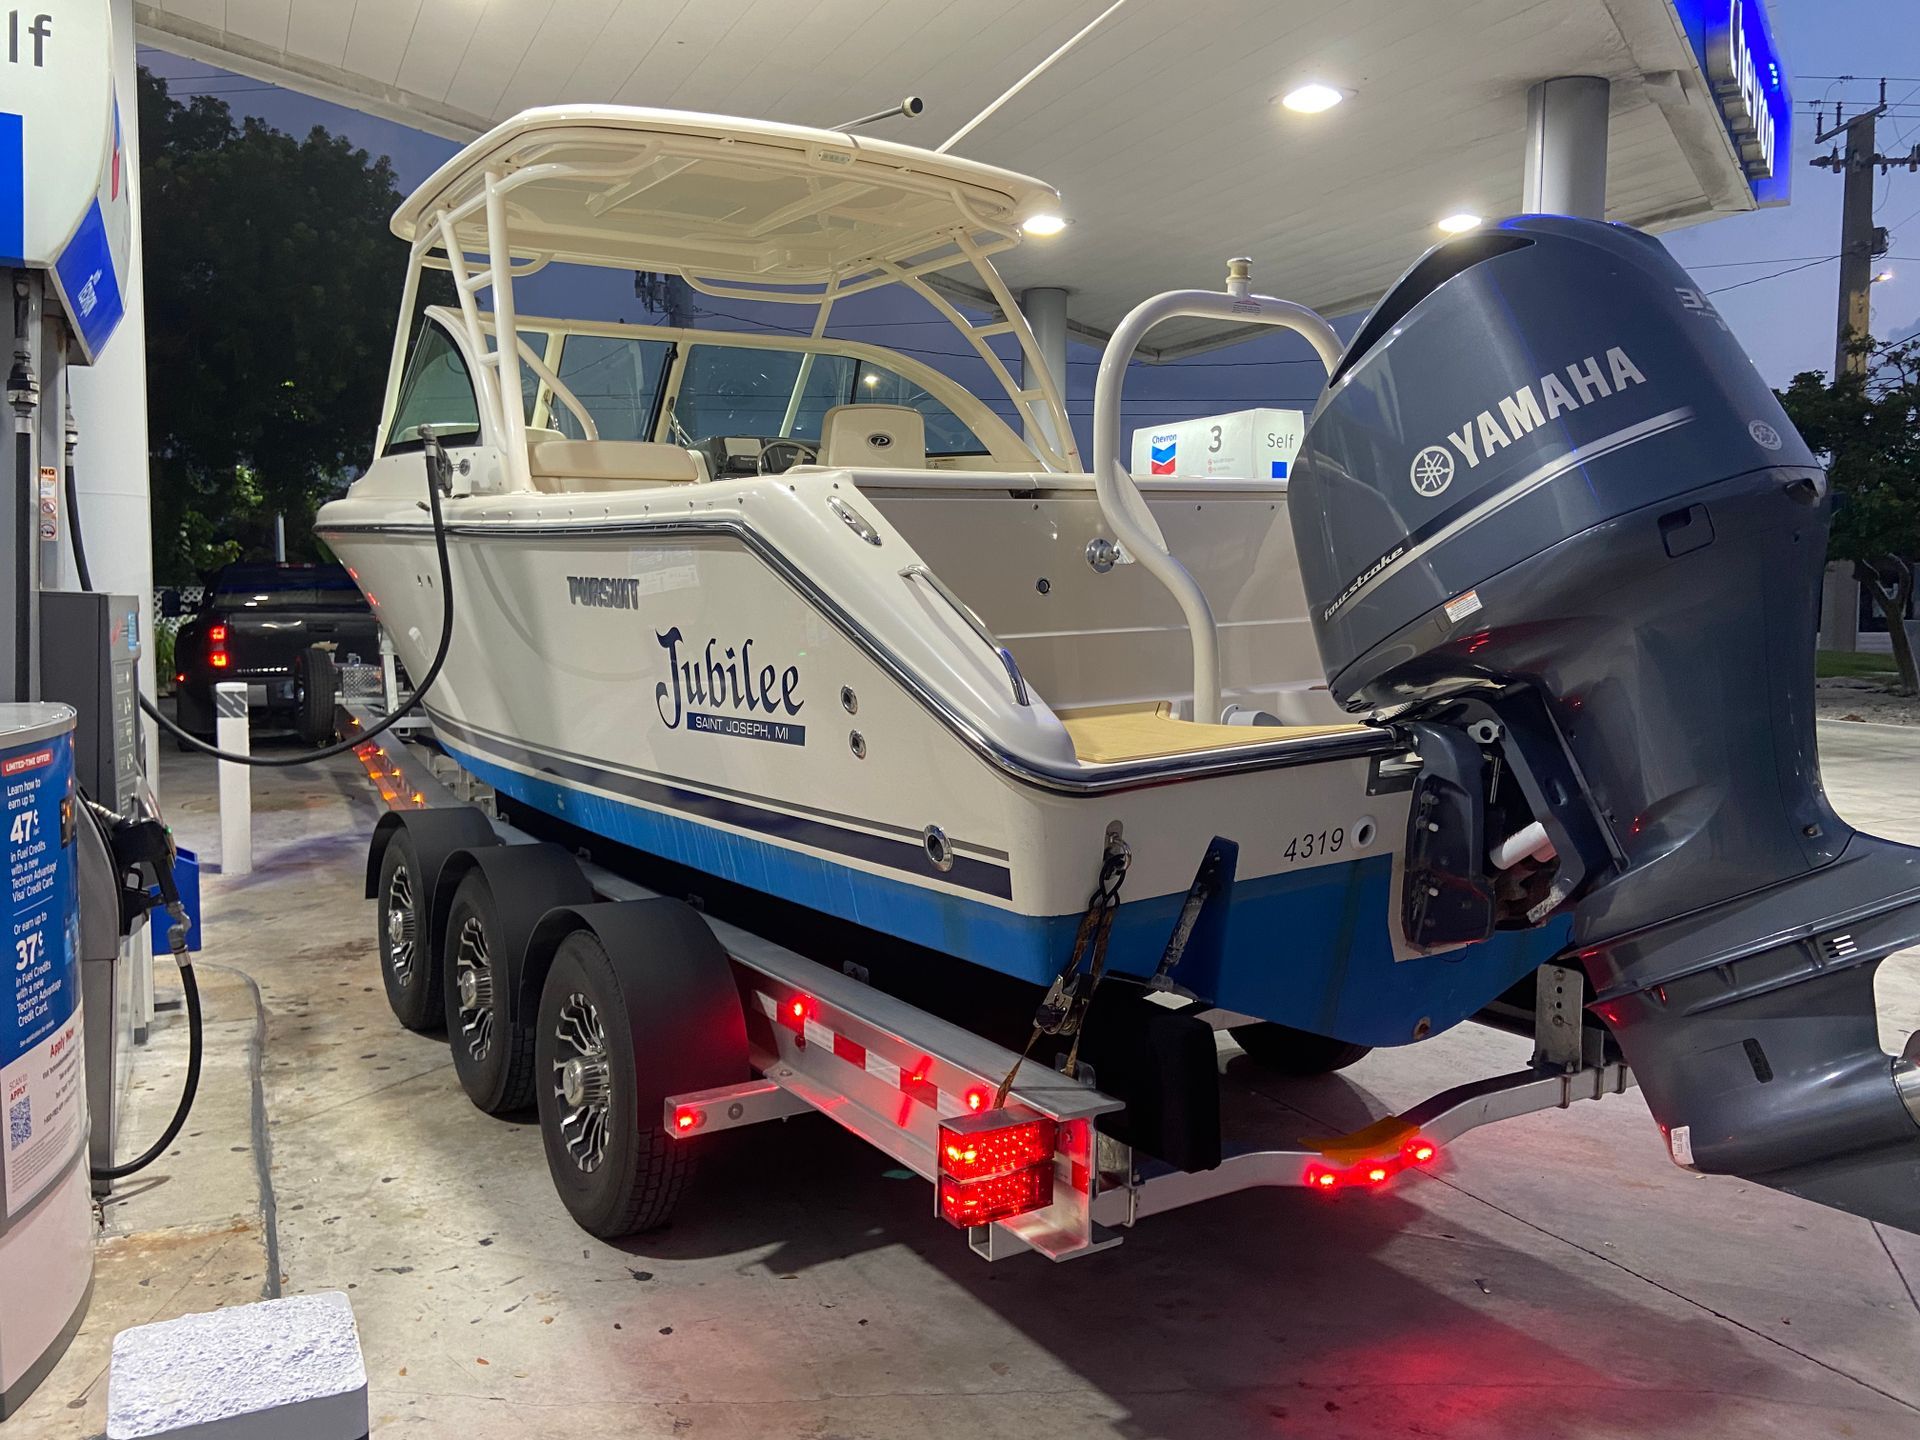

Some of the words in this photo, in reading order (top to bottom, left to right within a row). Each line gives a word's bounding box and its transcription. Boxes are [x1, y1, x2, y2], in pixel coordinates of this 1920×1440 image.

[9, 10, 52, 67] lf
[1447, 346, 1647, 468] YAMAHA
[1152, 433, 1177, 444] Chevron
[1208, 425, 1222, 453] 3
[1267, 433, 1294, 449] Self
[566, 576, 639, 610] PURSUIT
[655, 626, 805, 729] Jubilee
[695, 716, 722, 731] SAINT
[726, 720, 771, 739] JOSEPH,
[775, 726, 789, 741] MI
[7, 784, 24, 797] Learn
[24, 781, 35, 791] how
[35, 778, 41, 788] to
[8, 799, 20, 810] earn
[21, 796, 28, 807] up
[29, 793, 35, 804] to
[10, 852, 17, 863] in
[17, 846, 29, 860] Fuel
[29, 840, 46, 856] Credits
[1283, 828, 1344, 862] 4319
[11, 863, 24, 876] with
[24, 862, 28, 871] a
[28, 857, 39, 868] new
[12, 873, 33, 889] Techron
[27, 880, 41, 897] Credit
[14, 924, 21, 935] Or
[22, 919, 34, 932] earn
[34, 915, 41, 926] up
[41, 911, 48, 922] to
[16, 977, 21, 988] in
[22, 969, 34, 984] Fuel
[34, 960, 52, 977] Credits
[16, 986, 28, 1001] with
[33, 978, 44, 992] new
[17, 995, 39, 1014] Techron
[18, 1009, 35, 1027] Credit
[50, 1036, 65, 1058] Apply
[10, 1084, 27, 1102] APPLY
